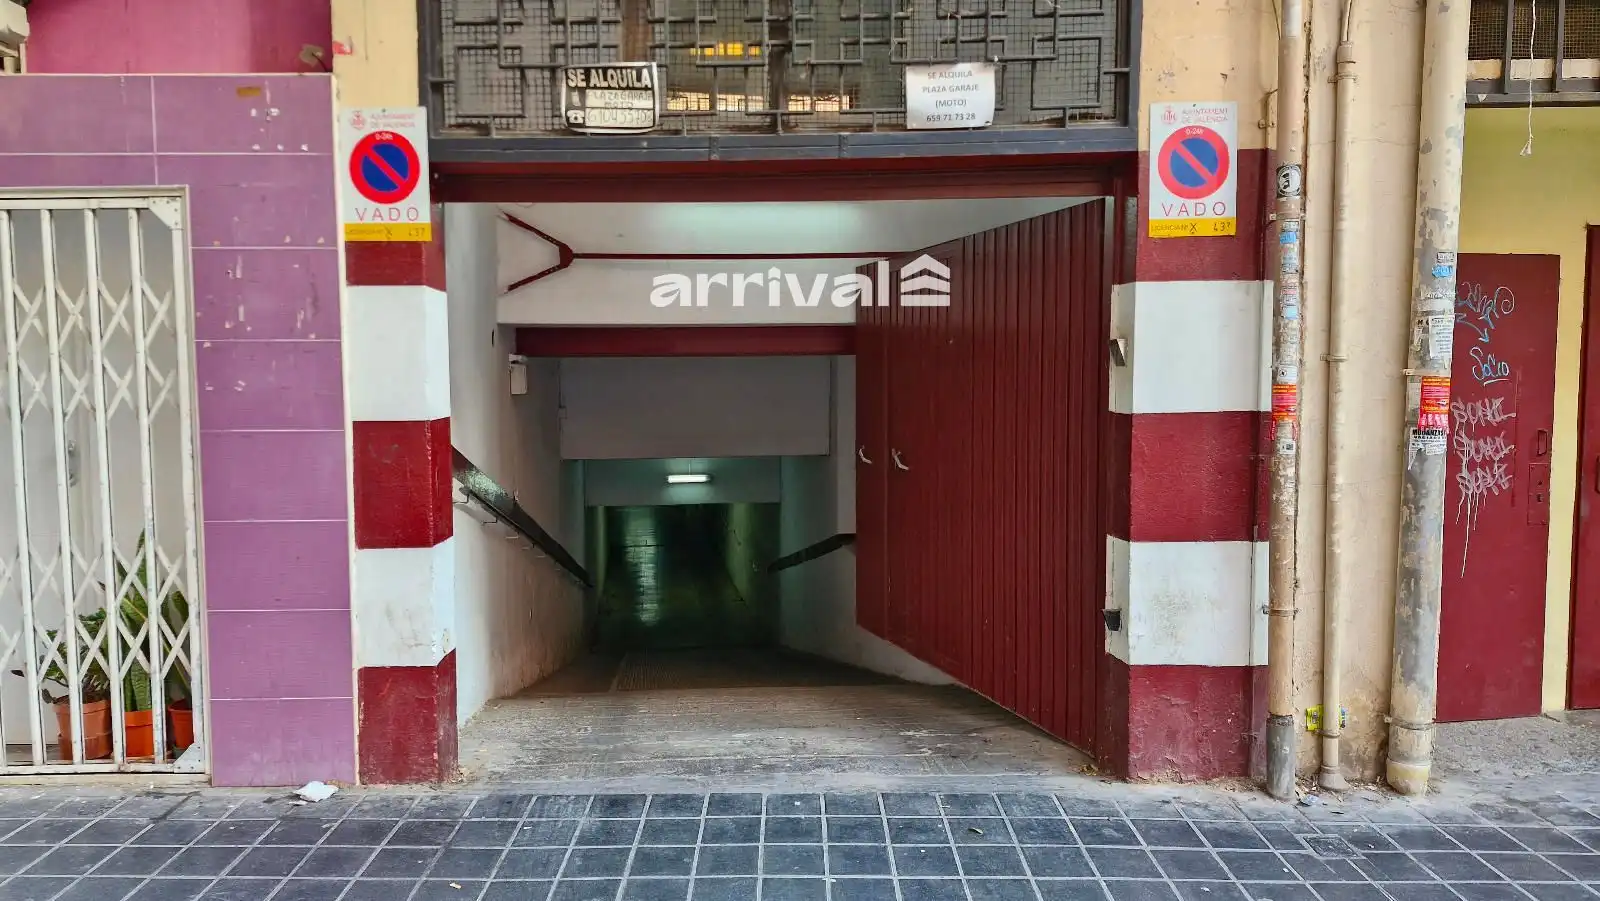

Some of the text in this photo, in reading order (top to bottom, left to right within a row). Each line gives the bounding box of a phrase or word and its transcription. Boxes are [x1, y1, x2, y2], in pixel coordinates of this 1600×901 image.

[567, 67, 652, 89] SE ALQUILA
[927, 70, 973, 80] SE ALQUILA
[922, 83, 980, 94] PLAZA GARAJE
[935, 99, 967, 109] (MOTO)
[926, 111, 976, 122] 659 71 73 28
[354, 206, 420, 222] VADO
[1161, 201, 1227, 217] VADO
